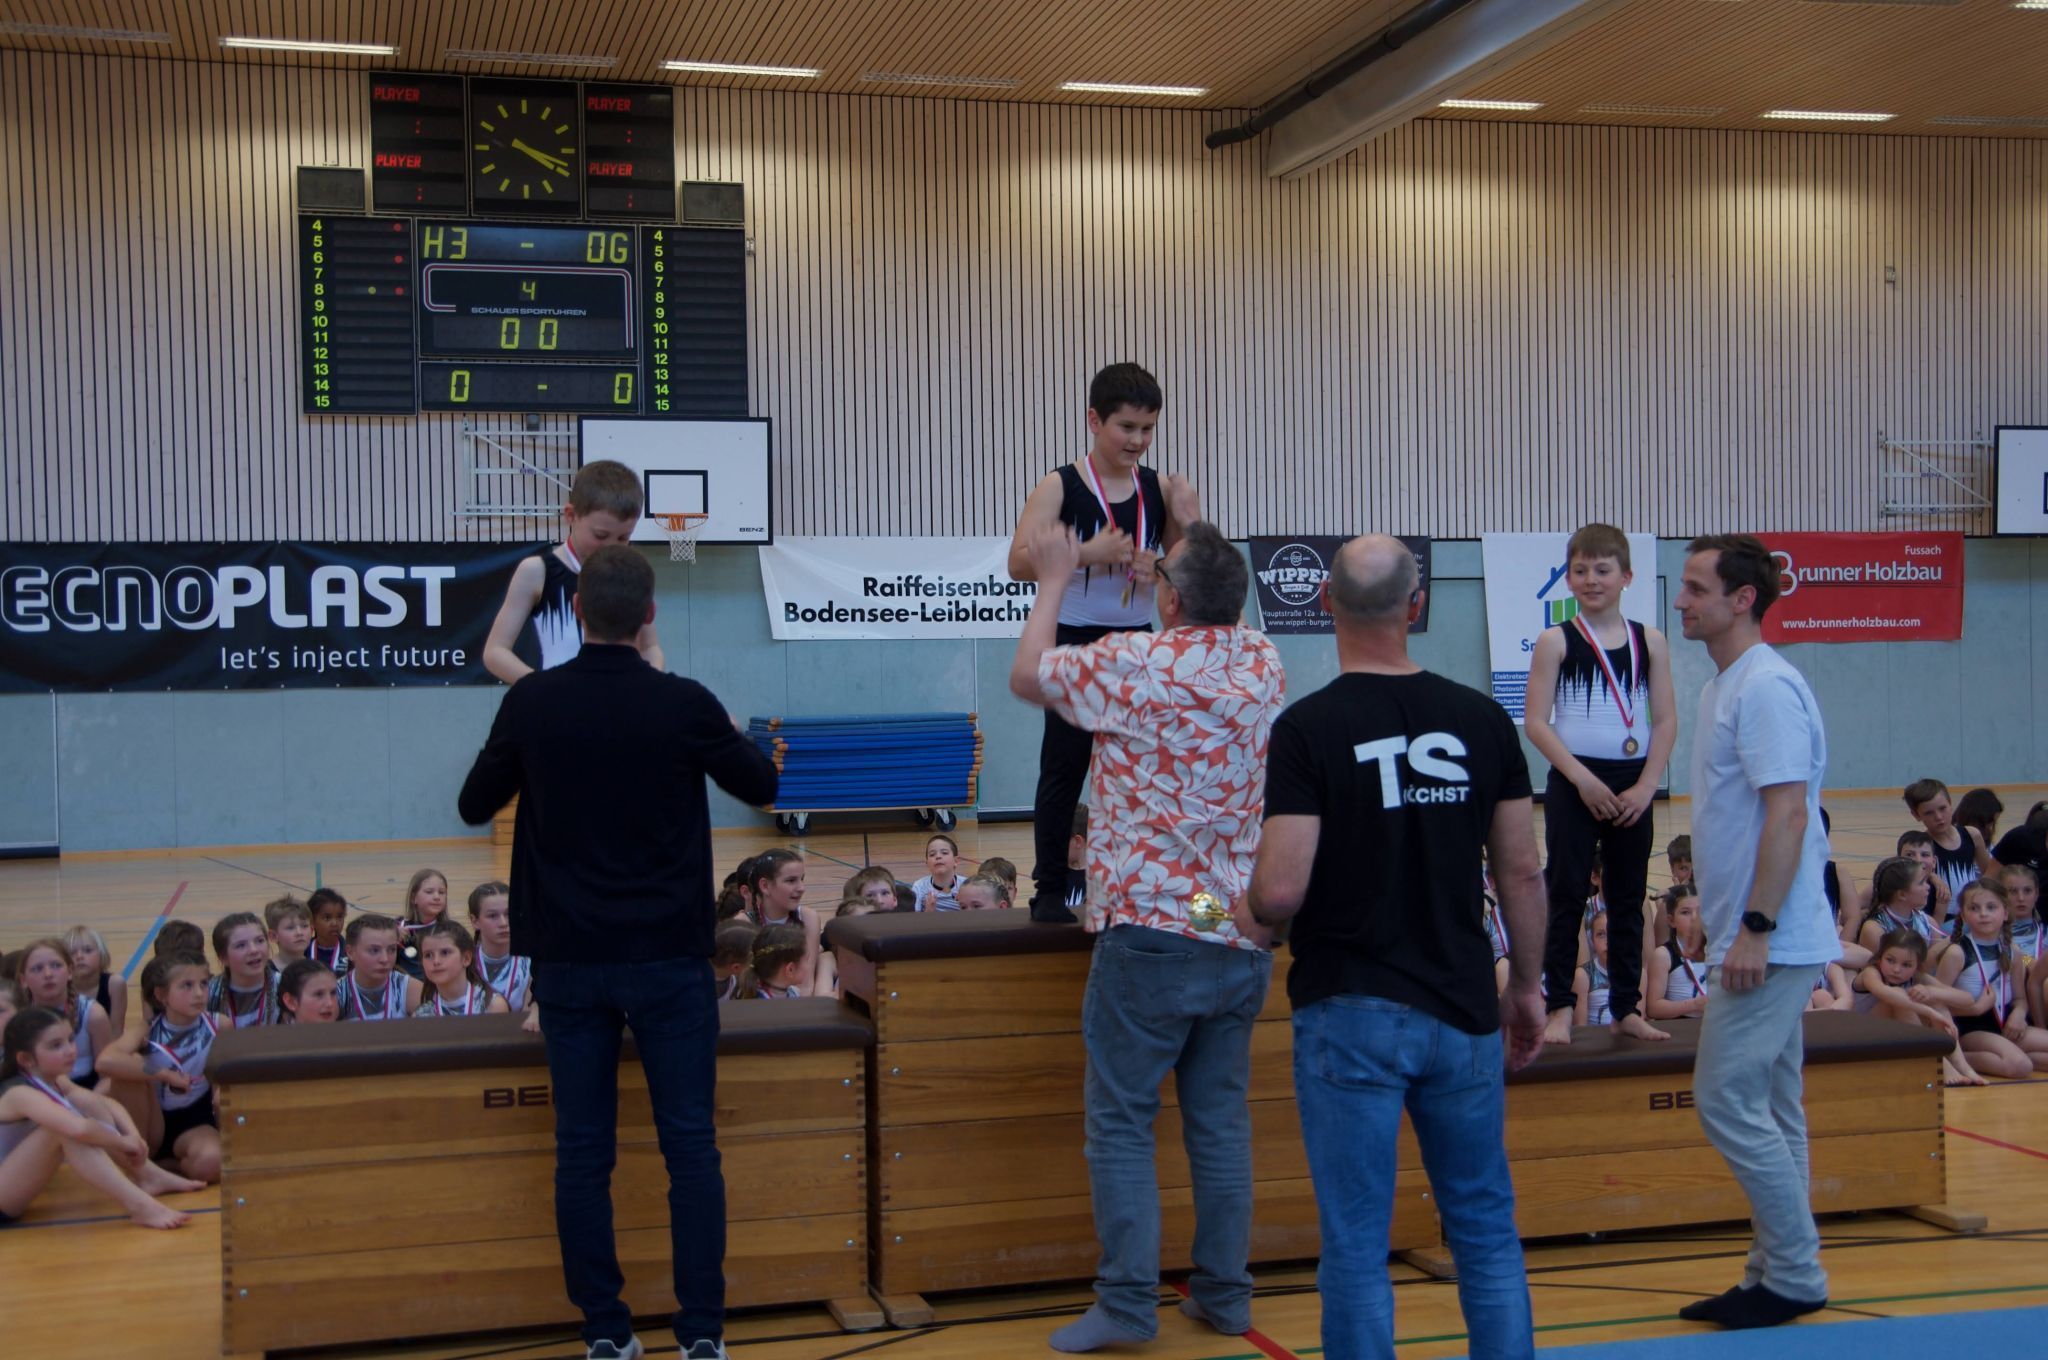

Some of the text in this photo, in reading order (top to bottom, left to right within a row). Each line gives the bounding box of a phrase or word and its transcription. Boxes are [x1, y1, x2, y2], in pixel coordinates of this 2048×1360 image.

[372, 86, 420, 102] PLAYER
[587, 96, 632, 112] PLAYER
[375, 154, 421, 168] PLAYER
[589, 162, 633, 176] PLAYER
[311, 220, 323, 231] 4
[312, 234, 324, 248] 5
[653, 230, 664, 241] 4
[654, 245, 664, 256] 5
[312, 251, 324, 264] 6
[653, 259, 665, 273] 6
[313, 267, 325, 279] 7
[655, 276, 665, 287] 7
[313, 283, 325, 296] 8
[521, 282, 537, 299] 4
[654, 291, 666, 305] 8
[313, 300, 325, 312] 9
[520, 308, 587, 316] SPORTUHREN
[654, 305, 665, 320] 9
[311, 316, 329, 328] 10
[652, 321, 669, 335] 10
[313, 332, 329, 344] 11
[654, 337, 669, 349] 11
[314, 346, 329, 360] 12
[654, 353, 668, 366] 12
[313, 363, 330, 376] 13
[655, 368, 669, 380] 13
[314, 380, 330, 390] 14
[449, 370, 471, 403] 0
[613, 373, 634, 404] 0
[655, 384, 670, 394] 14
[314, 395, 330, 408] 15
[655, 398, 671, 410] 15
[1905, 545, 1941, 554] Fussach
[1865, 561, 1942, 581] Holzbau
[1782, 617, 1921, 629] www.brunnerholzbau.com
[293, 646, 370, 673] inject
[381, 645, 466, 667] future
[1353, 732, 1469, 809] TS
